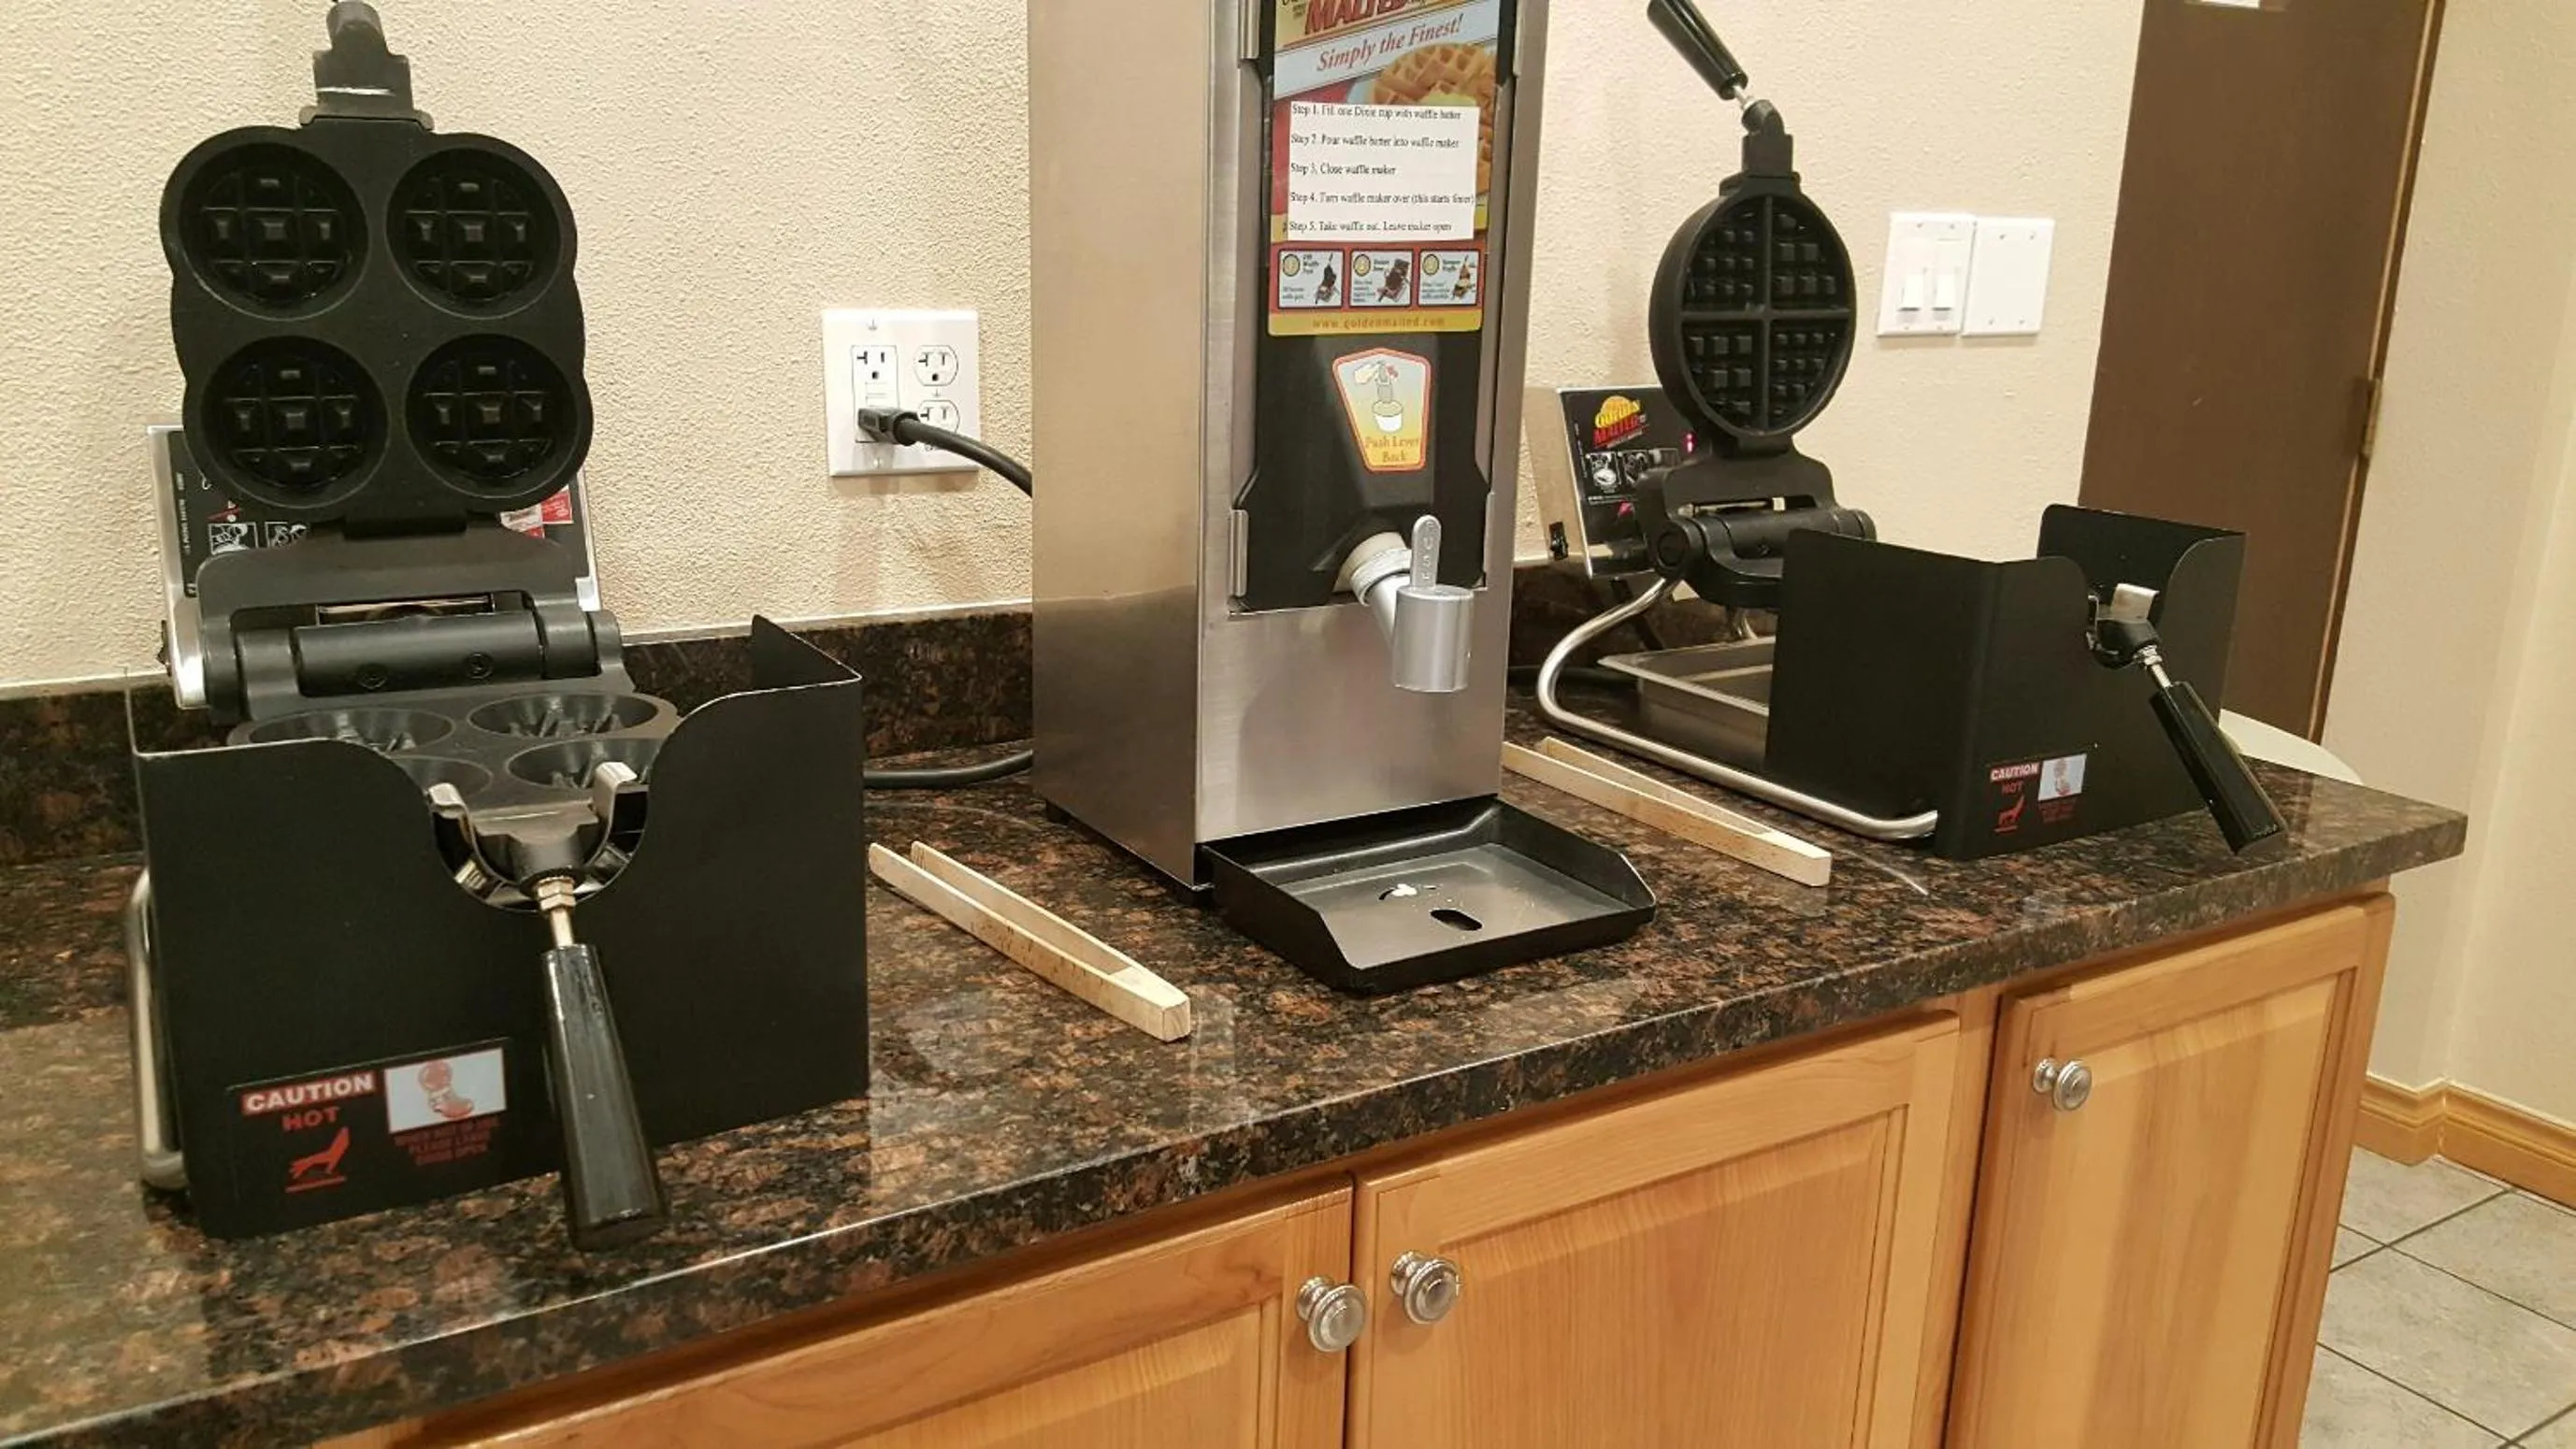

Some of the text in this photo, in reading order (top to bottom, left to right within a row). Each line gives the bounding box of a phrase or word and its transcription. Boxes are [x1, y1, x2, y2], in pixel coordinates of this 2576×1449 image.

[1305, 0, 1405, 35] MALT
[1317, 13, 1464, 71] Simply the Finest!
[1291, 163, 1308, 175] Step
[1319, 163, 1343, 175] Close
[1346, 165, 1369, 175] waffle
[1290, 192, 1308, 205] Step
[1341, 193, 1365, 203] waffle
[1289, 221, 1307, 234] Step
[1991, 762, 2039, 782] CAUTION
[246, 1074, 374, 1112] CAUTION
[282, 1107, 339, 1132] HOT
